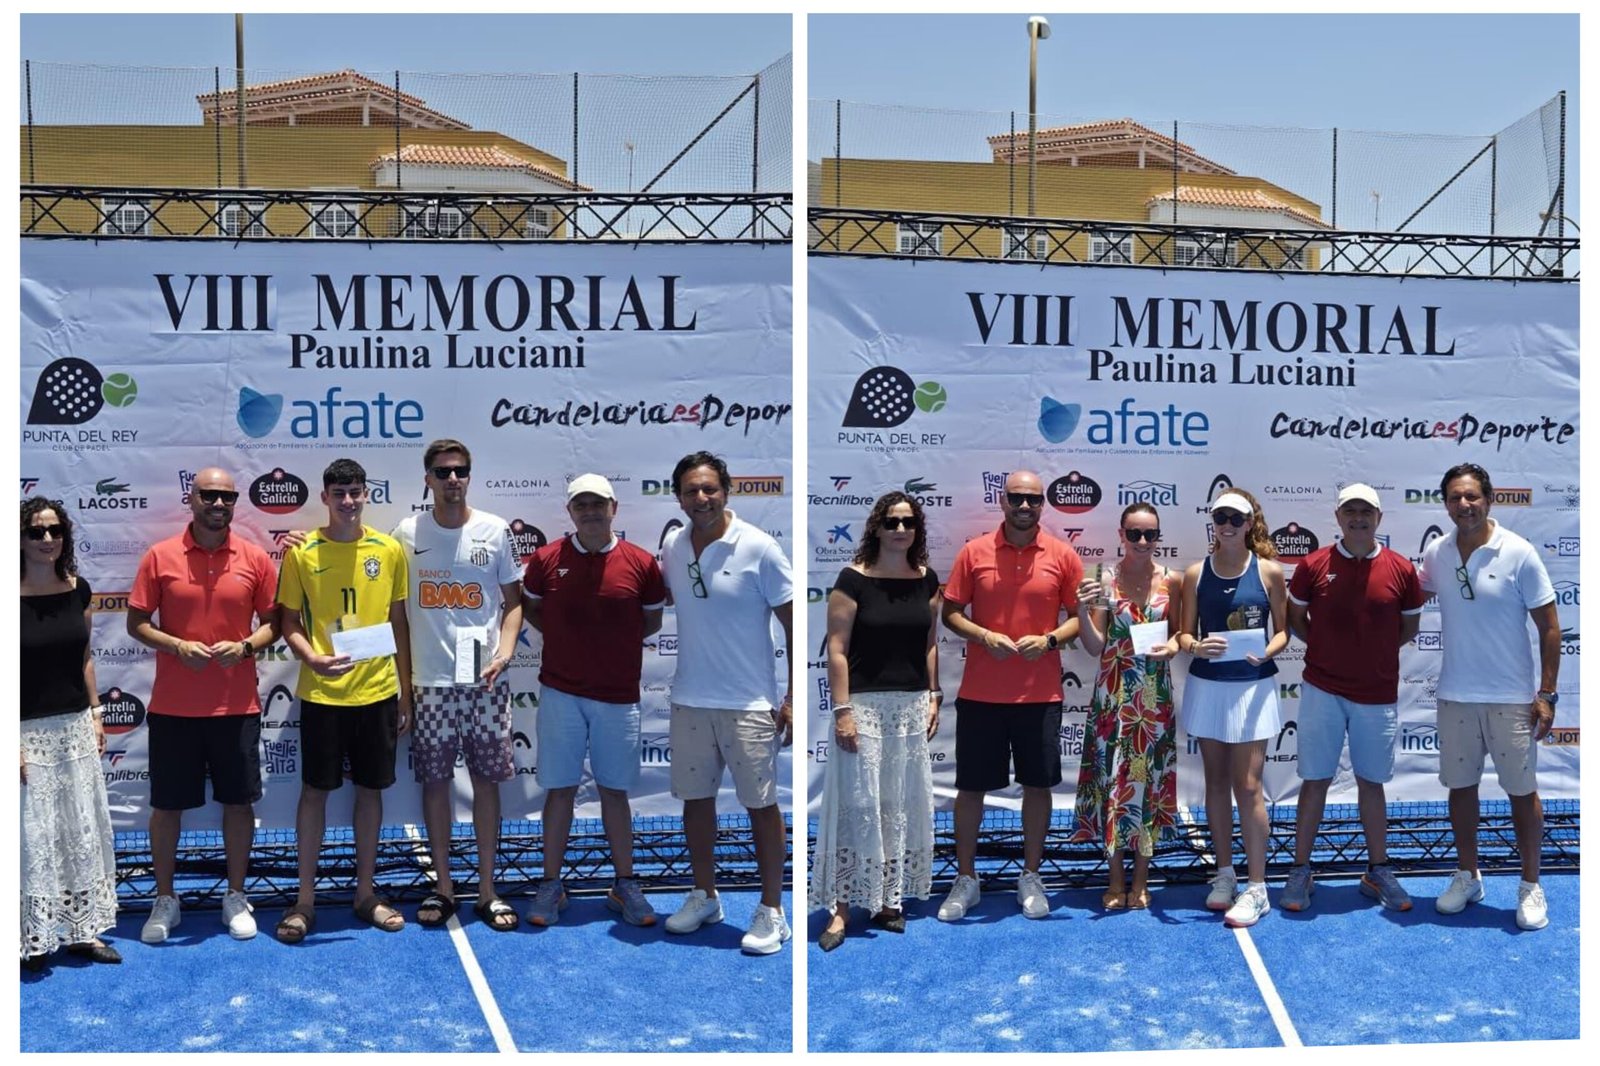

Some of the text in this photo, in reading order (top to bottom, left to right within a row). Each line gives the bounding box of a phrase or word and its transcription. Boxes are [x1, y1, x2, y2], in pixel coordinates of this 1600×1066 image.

[153, 274, 697, 332] VIII MEMORIAL
[965, 292, 1456, 357] VIII MEMORIAL
[288, 333, 586, 369] Paulina Luciani
[1086, 349, 1356, 388] Paulina Luciani
[290, 386, 425, 439] afate
[491, 394, 792, 437] CandelariaesDepor
[1087, 398, 1210, 447] afate
[23, 430, 139, 443] PUNTA DEL REY
[837, 432, 947, 445] PUNTA DEL REY
[52, 444, 73, 452] CLUB
[86, 444, 110, 452] PADEL
[258, 481, 299, 494] Estrella
[486, 479, 550, 488] CATALONIA
[737, 481, 781, 493] JOTUN
[1055, 483, 1094, 495] Estrella
[1264, 485, 1323, 494] CATALONIA
[259, 492, 298, 505] Galicia
[807, 495, 874, 507] Tecnifibre
[915, 495, 953, 507] OSTE
[1056, 493, 1092, 506] Galicia
[1118, 483, 1180, 507] inetel
[1405, 489, 1443, 504] DK
[79, 497, 148, 510] LACOSTE
[1275, 534, 1311, 546] Estrella
[815, 546, 837, 556] Obra
[1276, 544, 1310, 555] Galicia
[418, 569, 452, 579] BANCO
[341, 587, 357, 615] 11
[419, 581, 483, 609] BMG
[517, 650, 541, 660] Social
[101, 701, 136, 712] strella
[1557, 732, 1580, 743] JOT
